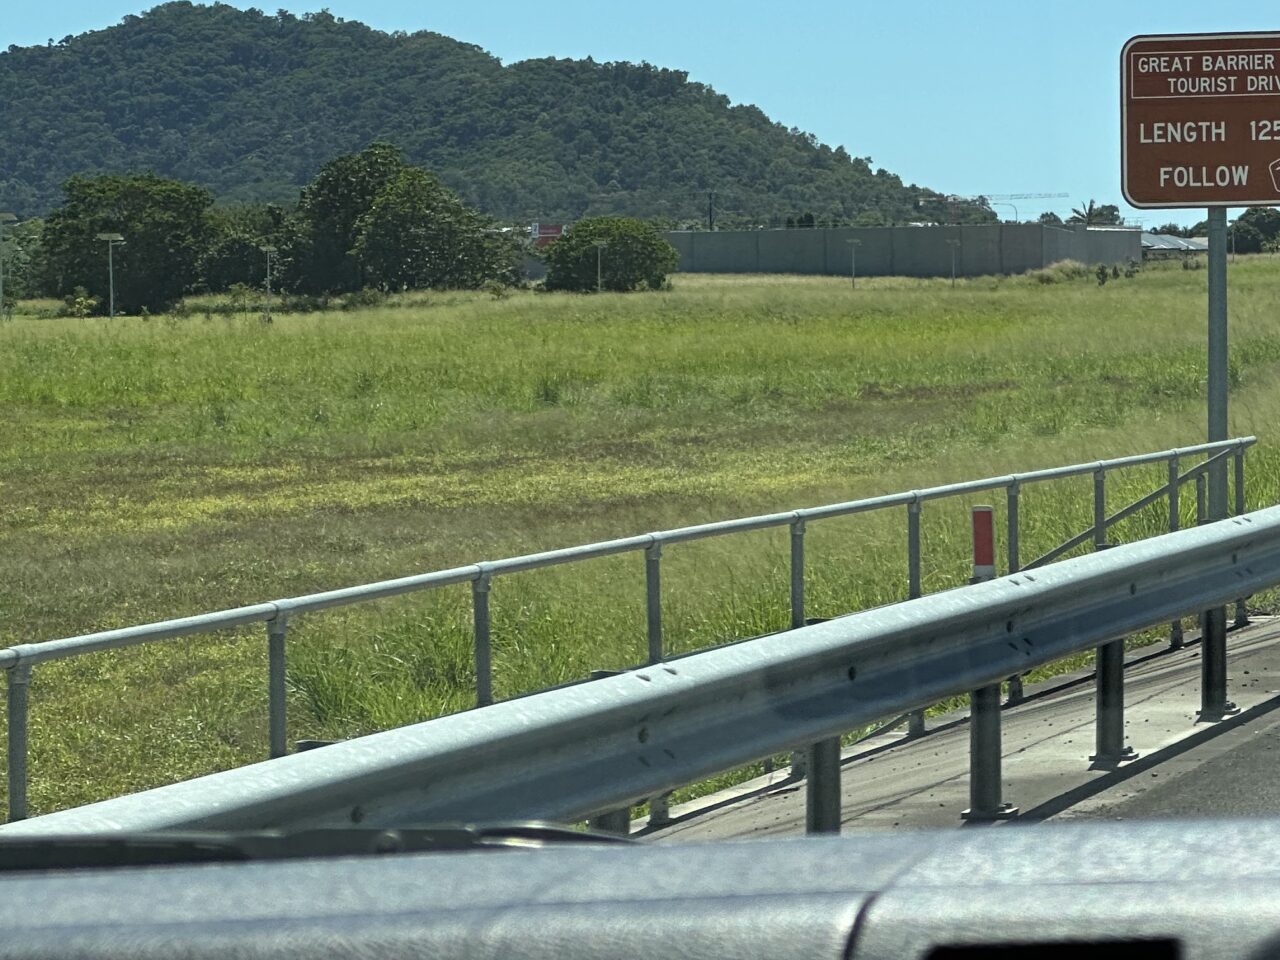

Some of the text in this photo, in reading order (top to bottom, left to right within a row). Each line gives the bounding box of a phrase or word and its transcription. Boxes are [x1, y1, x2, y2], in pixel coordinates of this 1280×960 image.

[1138, 56, 1193, 73] GREAT
[1202, 54, 1275, 71] BARRIER
[1168, 76, 1237, 93] TOURIST
[1139, 121, 1226, 144] LENGTH
[1159, 165, 1249, 187] FOLLOW
